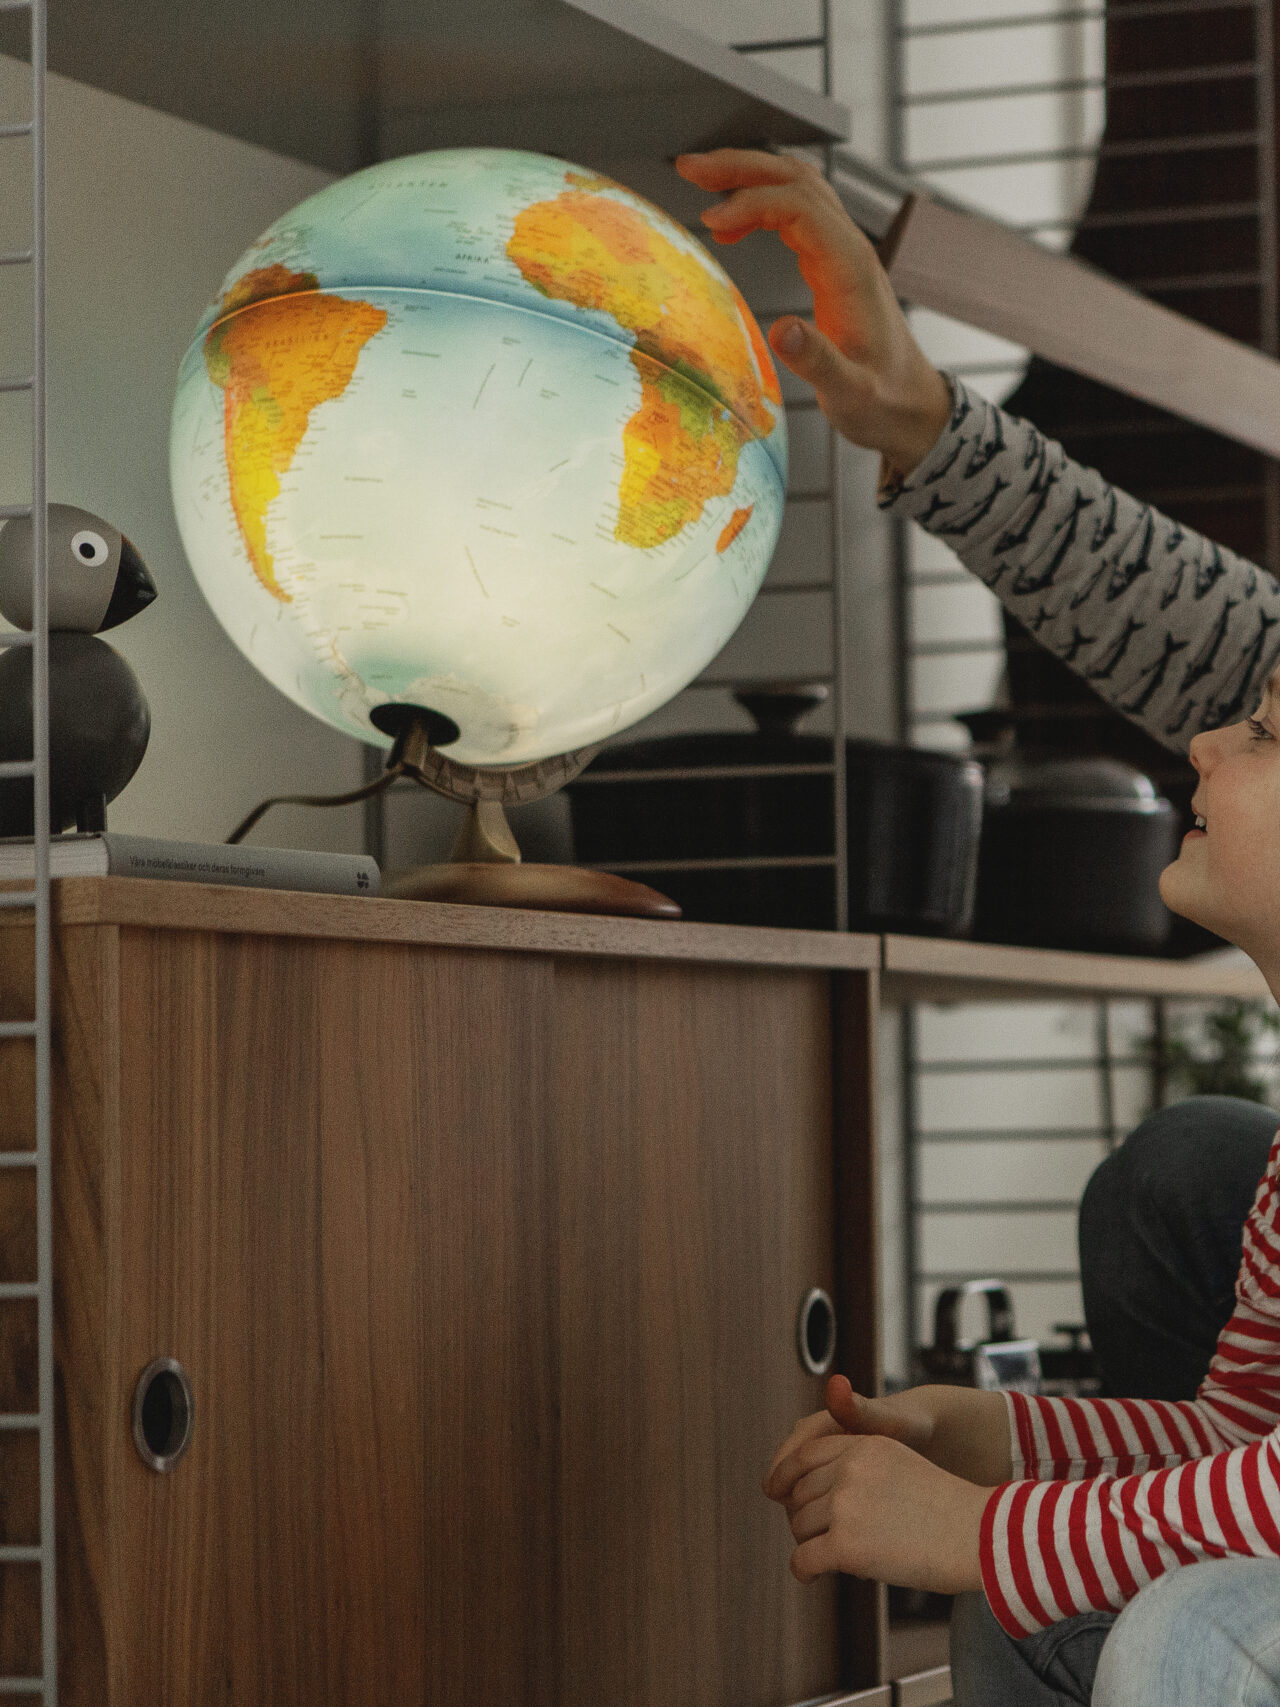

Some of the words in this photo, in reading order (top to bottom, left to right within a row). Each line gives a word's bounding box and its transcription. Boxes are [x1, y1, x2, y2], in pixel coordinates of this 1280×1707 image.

[455, 253, 490, 264] AFRIKA
[198, 862, 210, 872] och
[211, 863, 229, 874] deras
[230, 865, 265, 878] formgivare
